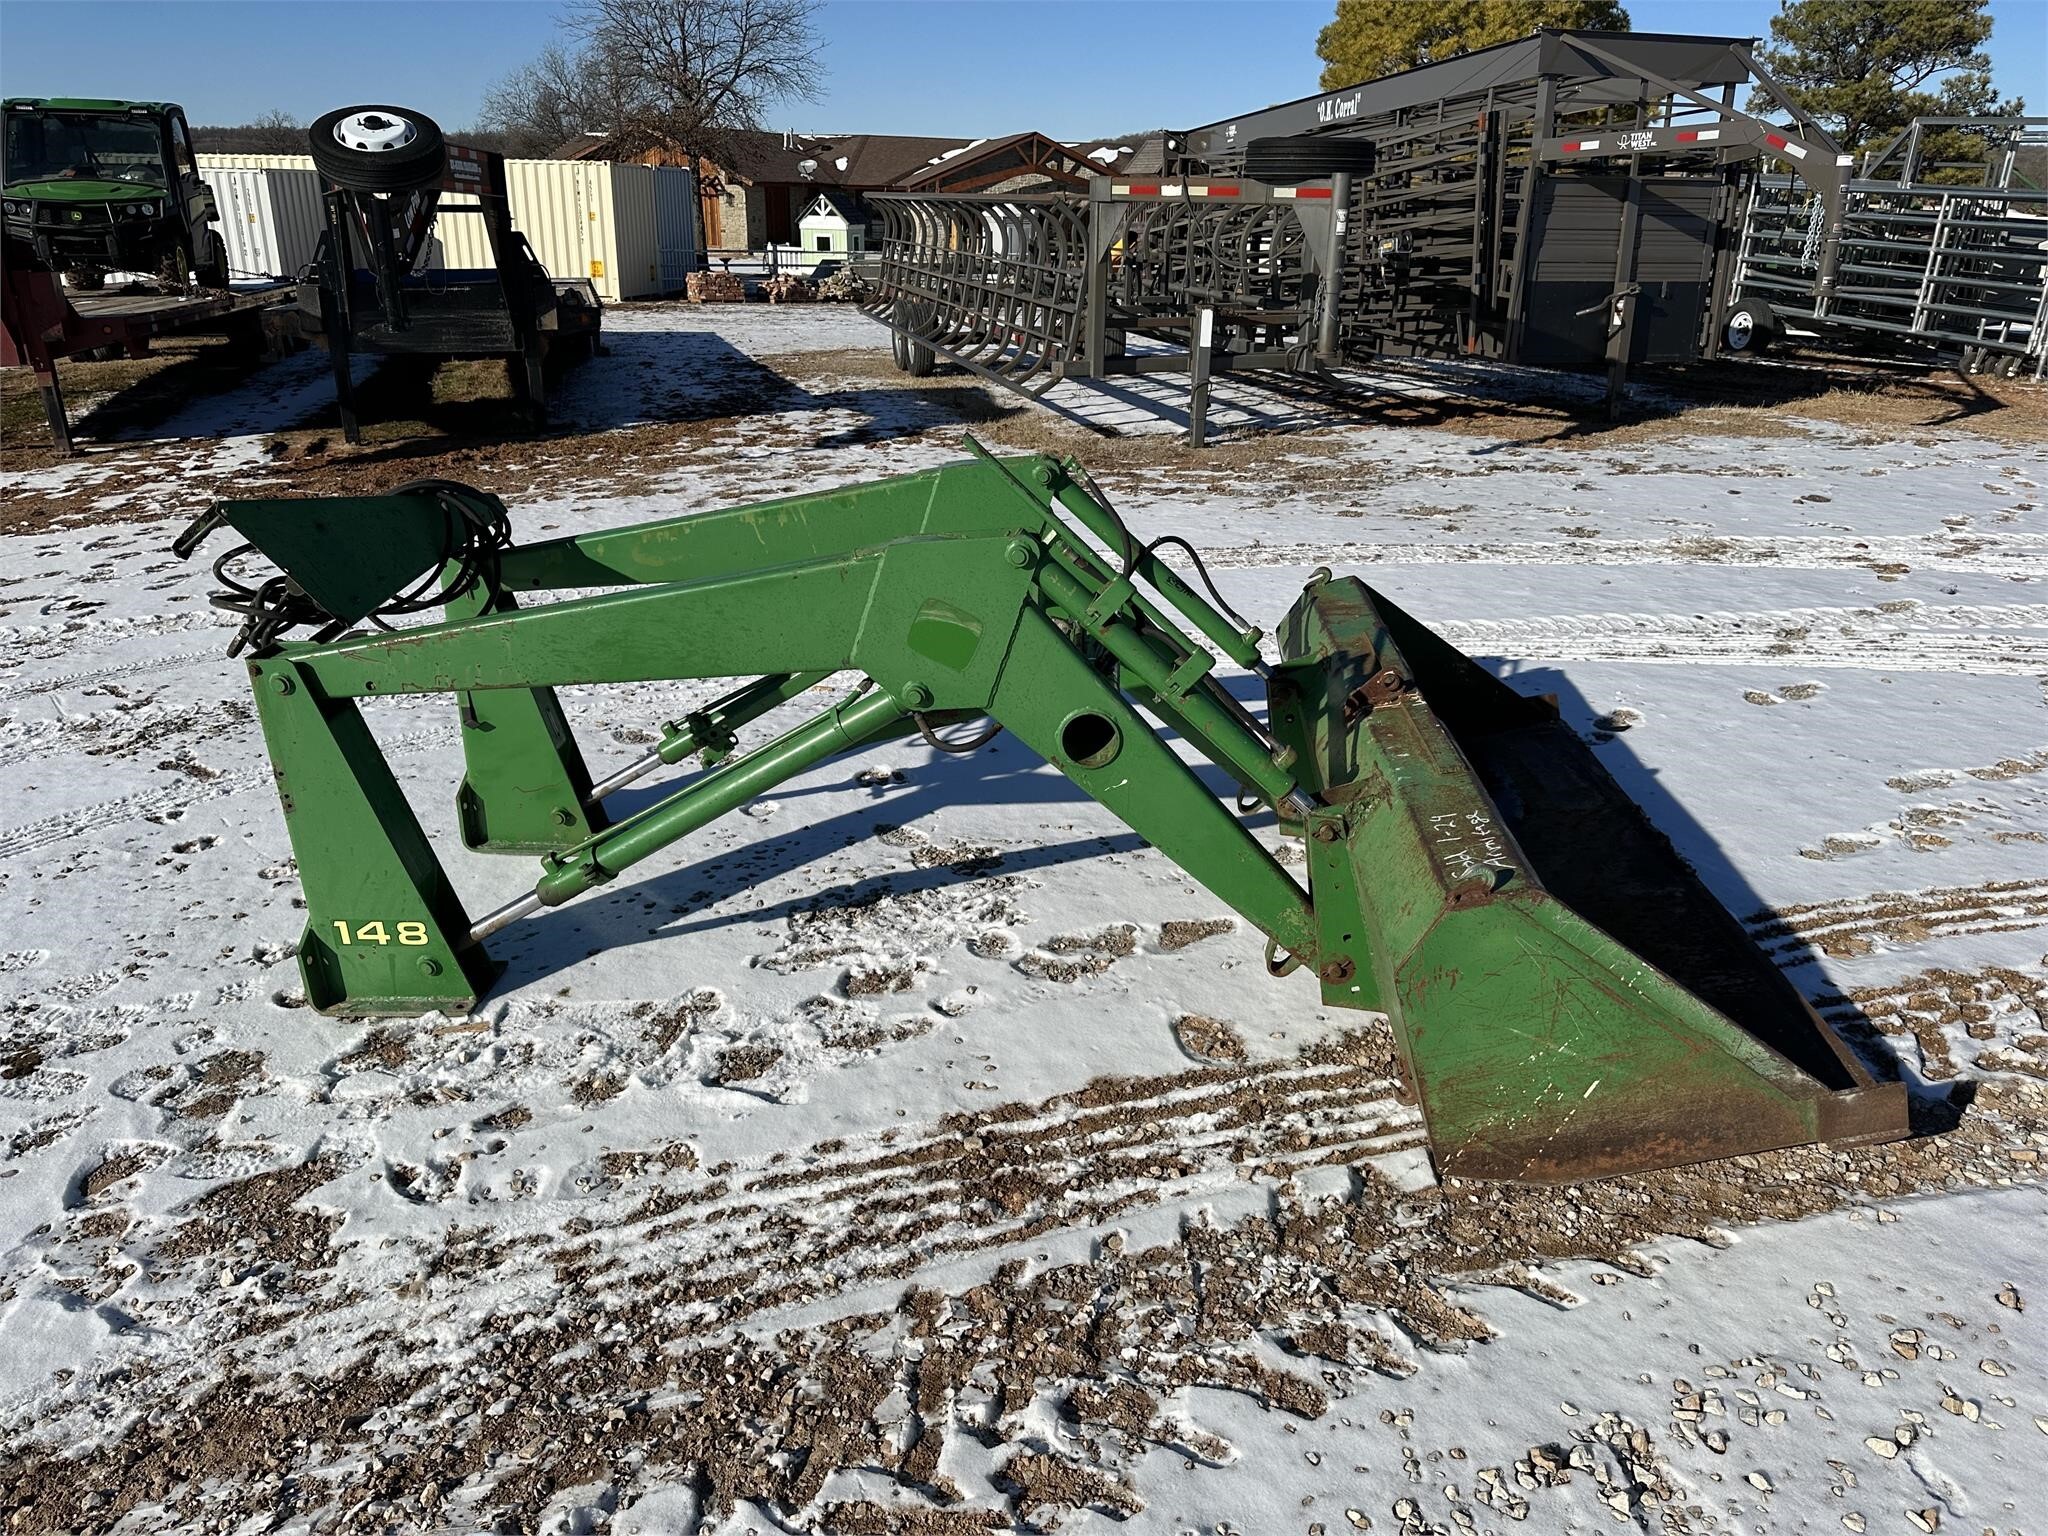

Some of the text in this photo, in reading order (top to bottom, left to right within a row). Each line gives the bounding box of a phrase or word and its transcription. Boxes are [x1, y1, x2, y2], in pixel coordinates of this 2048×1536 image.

[1630, 131, 1653, 141] TITAN
[1631, 139, 1652, 148] WEST
[333, 920, 430, 946] 148
